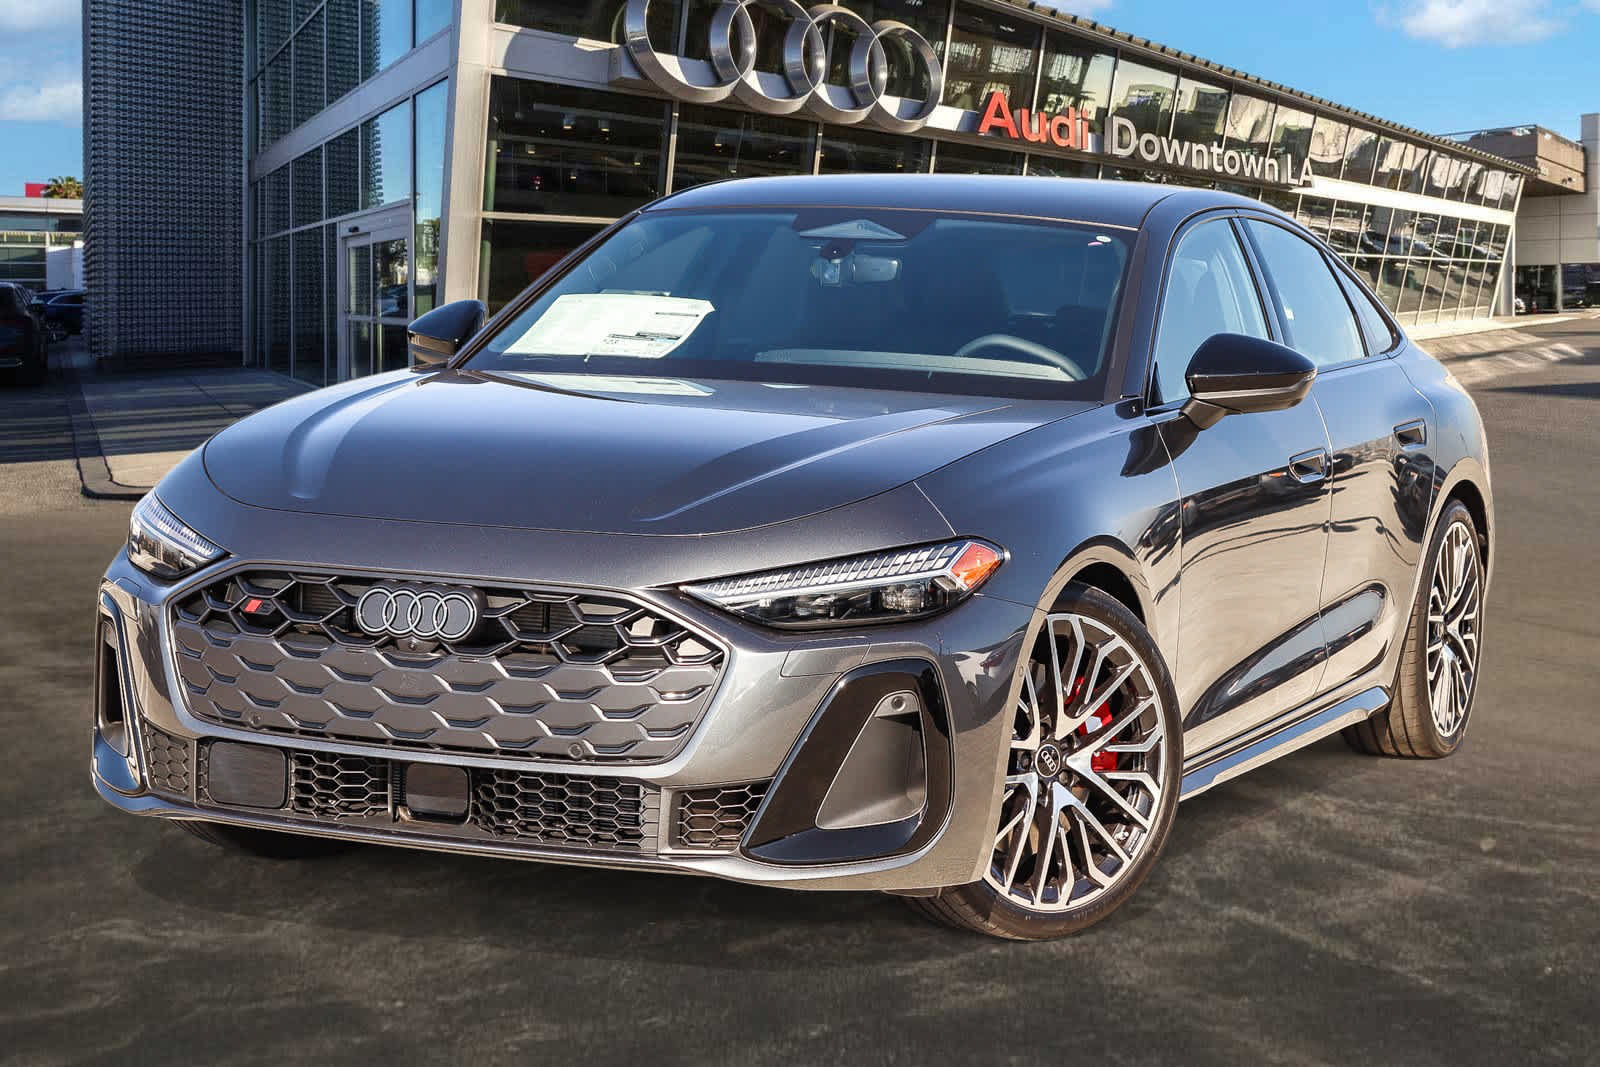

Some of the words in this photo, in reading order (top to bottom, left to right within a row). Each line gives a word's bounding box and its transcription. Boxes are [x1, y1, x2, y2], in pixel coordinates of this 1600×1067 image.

[979, 91, 1089, 150] Audi
[1106, 116, 1280, 181] Downtown
[1286, 153, 1314, 187] LA
